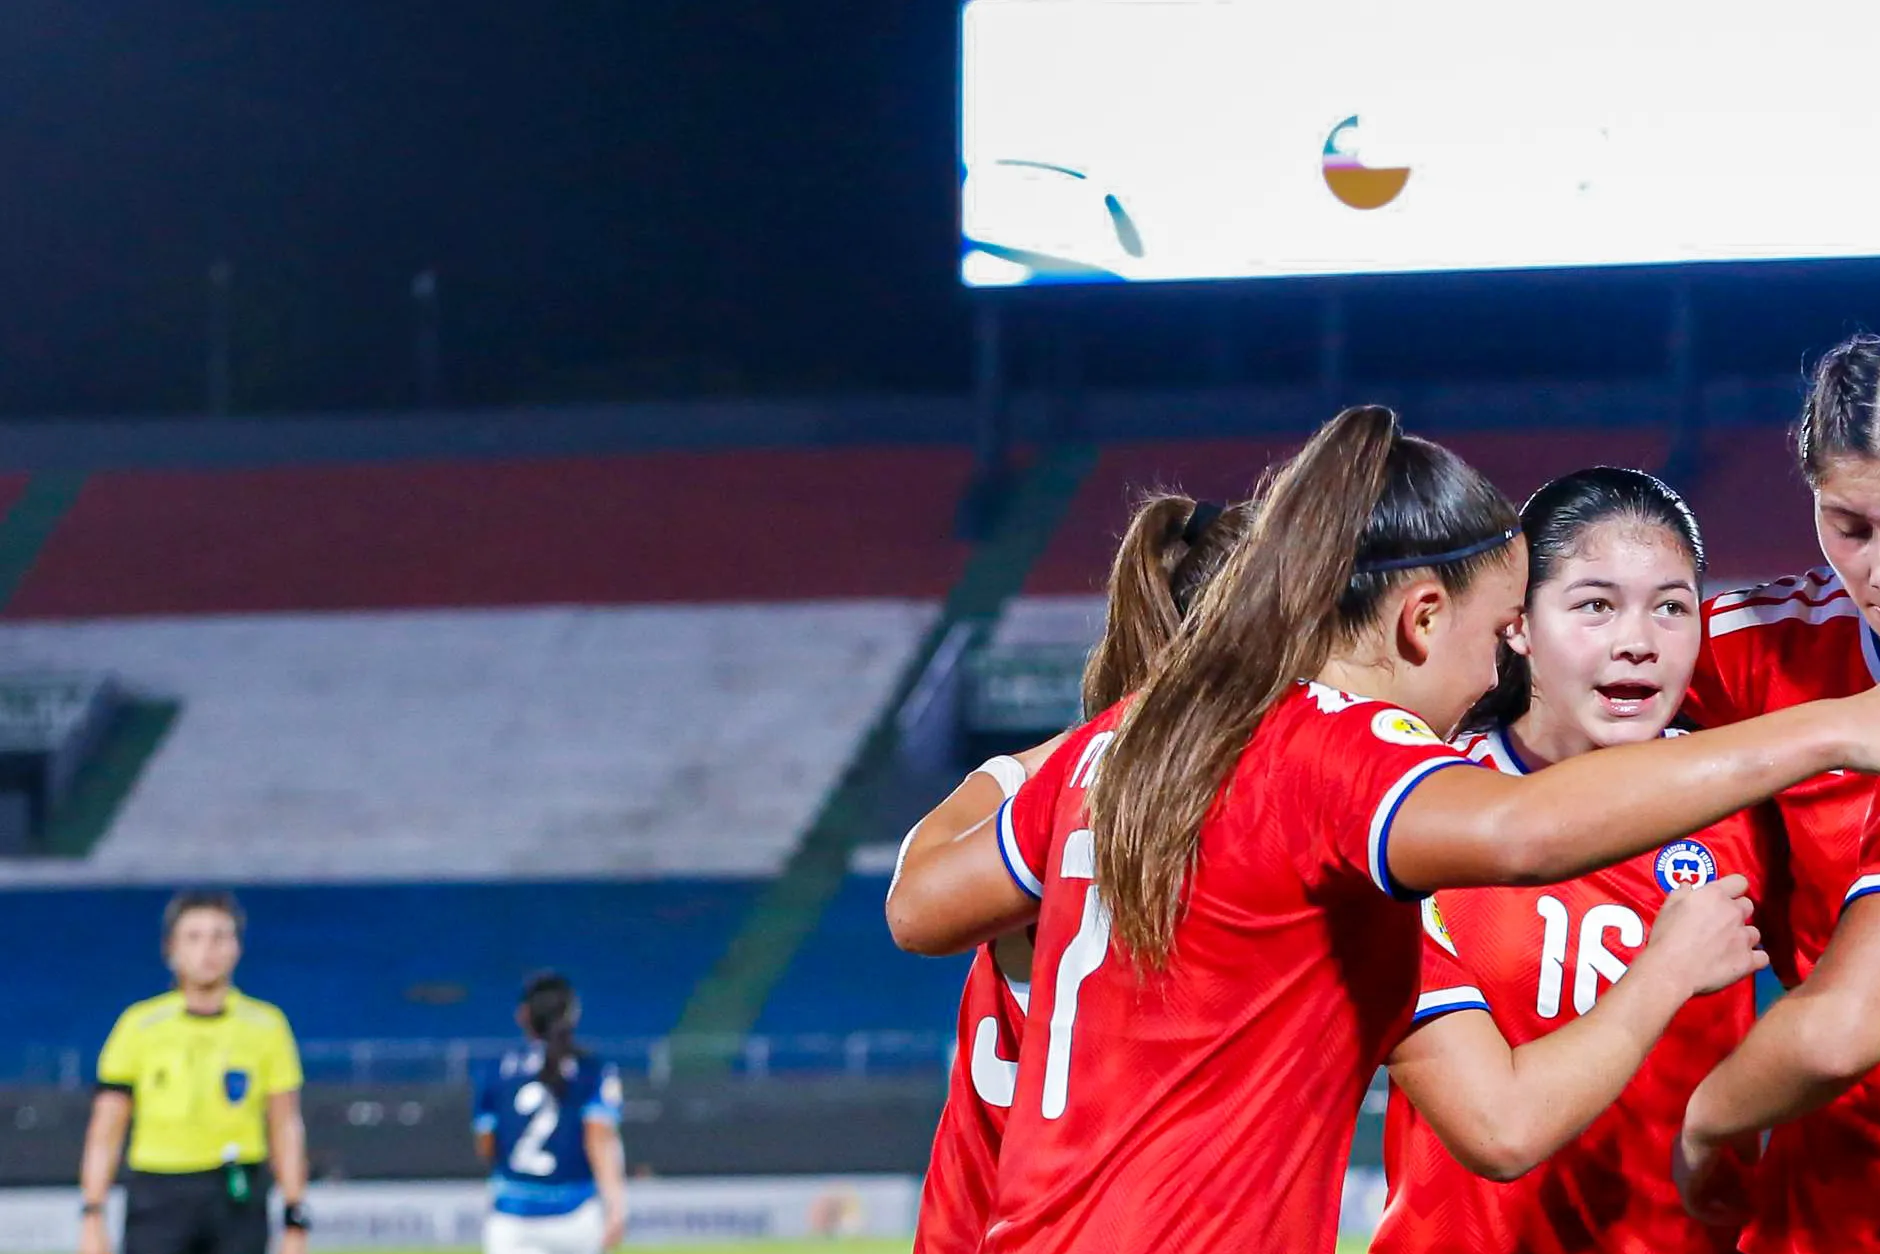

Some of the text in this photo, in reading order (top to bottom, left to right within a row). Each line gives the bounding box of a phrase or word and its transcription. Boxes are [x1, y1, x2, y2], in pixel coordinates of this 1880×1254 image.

[1690, 845, 1699, 854] DE
[1700, 851, 1714, 874] FUTBOL
[1040, 828, 1114, 1120] 7
[509, 1081, 559, 1177] 2
